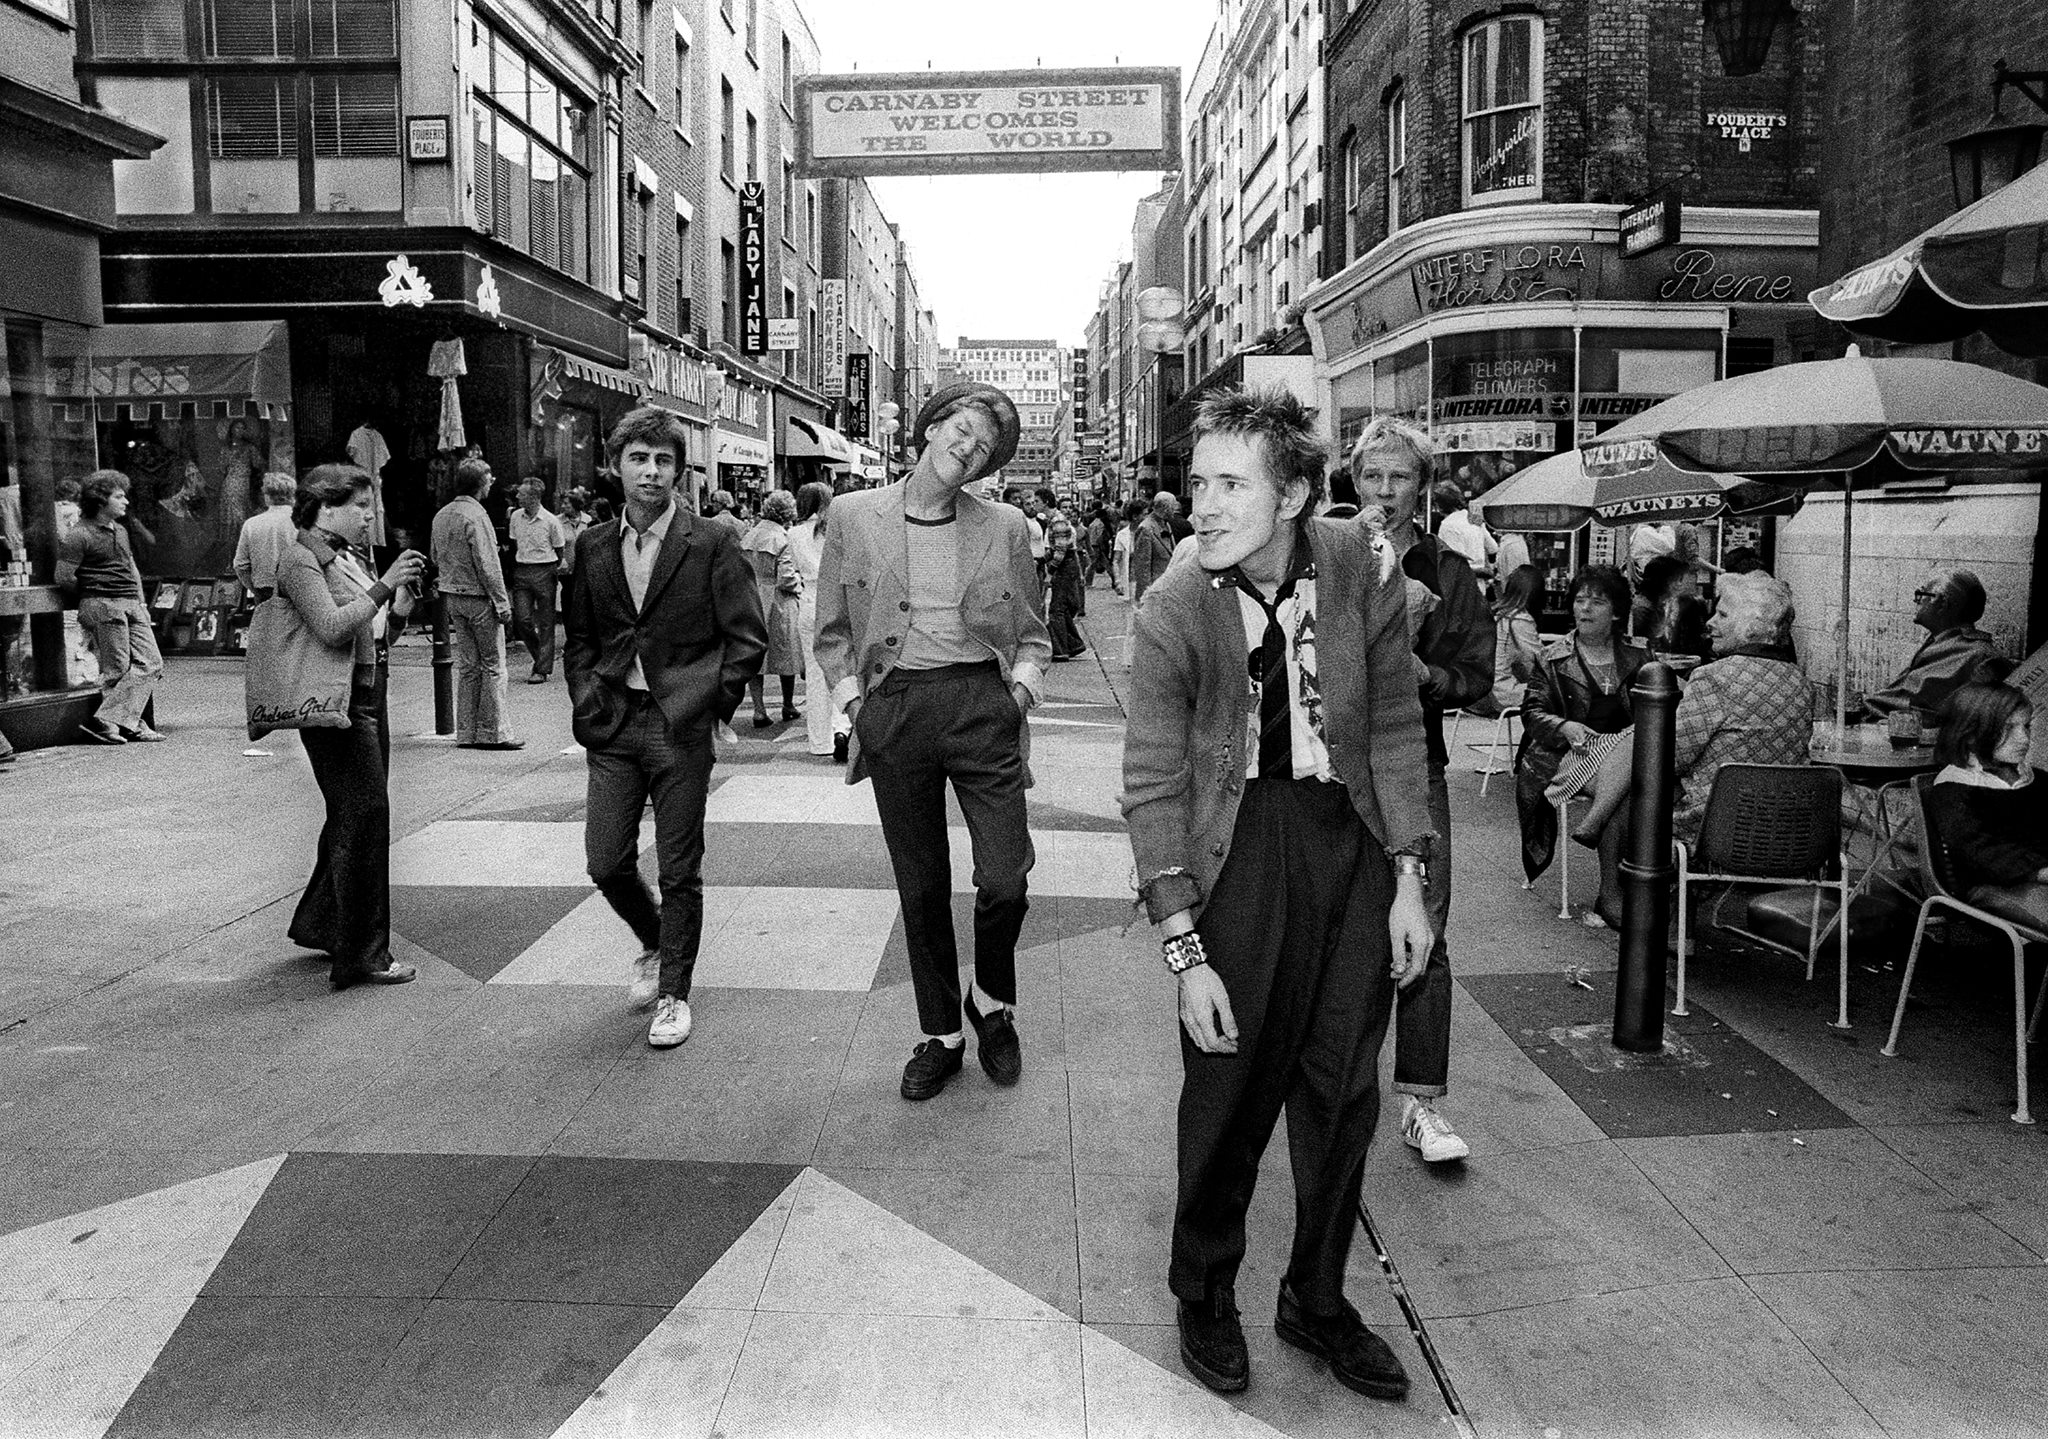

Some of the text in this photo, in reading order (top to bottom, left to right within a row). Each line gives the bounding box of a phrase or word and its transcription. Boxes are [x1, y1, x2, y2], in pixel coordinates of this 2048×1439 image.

[825, 90, 1149, 113] CARNABY STREET
[889, 111, 1079, 131] WELCOMES
[1706, 113, 1787, 126] FOUBERT'S
[861, 131, 1113, 151] THE WORLD
[1721, 126, 1772, 139] PLACE
[1418, 246, 1587, 283] INTERFLORA
[746, 213, 761, 350] LADY JANE
[824, 281, 834, 377] CARNABY
[648, 346, 669, 394] SIR
[1469, 358, 1556, 378] TELEGRAPH
[859, 358, 867, 432] SELLARS
[1473, 378, 1547, 395] FLOWERS
[1443, 398, 1544, 418] INTERFLORA
[1579, 398, 1666, 415] INTERFL
[1890, 430, 2048, 453] WATNE
[1595, 493, 1722, 518] WATNEYS
[251, 697, 341, 722] Chelsea Girl
